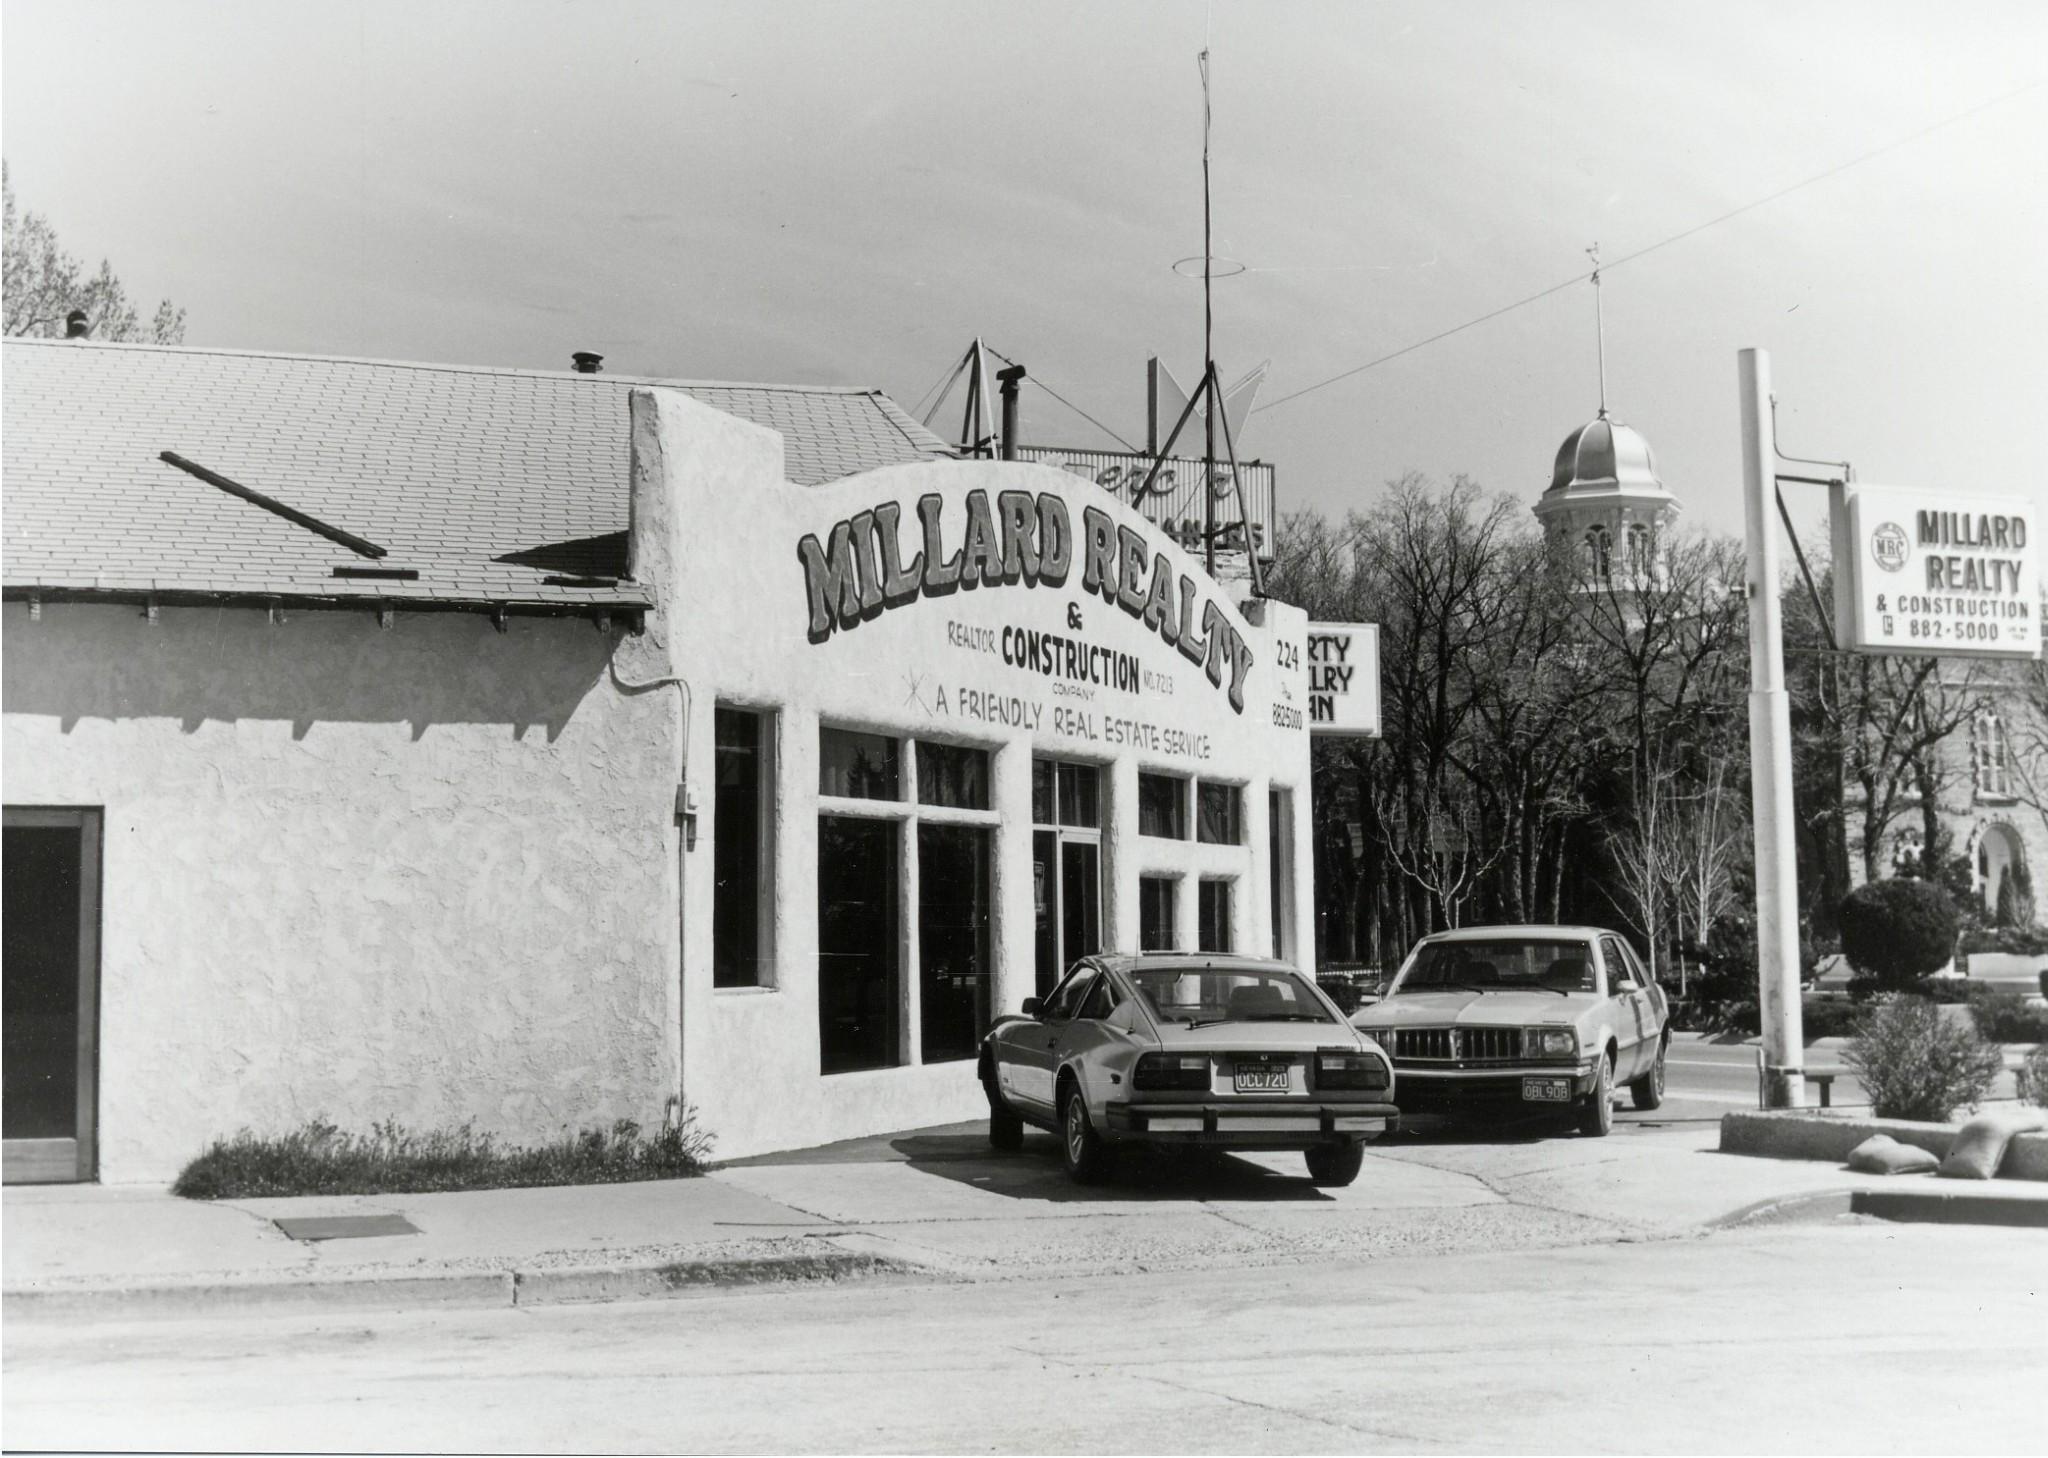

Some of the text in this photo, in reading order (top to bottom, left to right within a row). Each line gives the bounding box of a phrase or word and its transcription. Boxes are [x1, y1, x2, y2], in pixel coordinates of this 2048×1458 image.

[1917, 509, 2027, 549] MILLARD
[1876, 538, 1904, 556] MRC
[1925, 555, 2023, 594] REALTY
[798, 488, 1254, 715] MILLARD REALTY
[1067, 601, 1083, 631] &
[1876, 593, 2029, 619] & CONSTRUCTION
[948, 620, 997, 654] REALTOR
[1002, 625, 1140, 695] CONSTRUCTION
[1277, 639, 1299, 672] 224
[1308, 635, 1351, 662] RTY
[1053, 682, 1096, 702] COMPANY
[1308, 665, 1354, 692] LRY
[936, 684, 1211, 760] A FRIENDLY REAL ESTATE SERVICE
